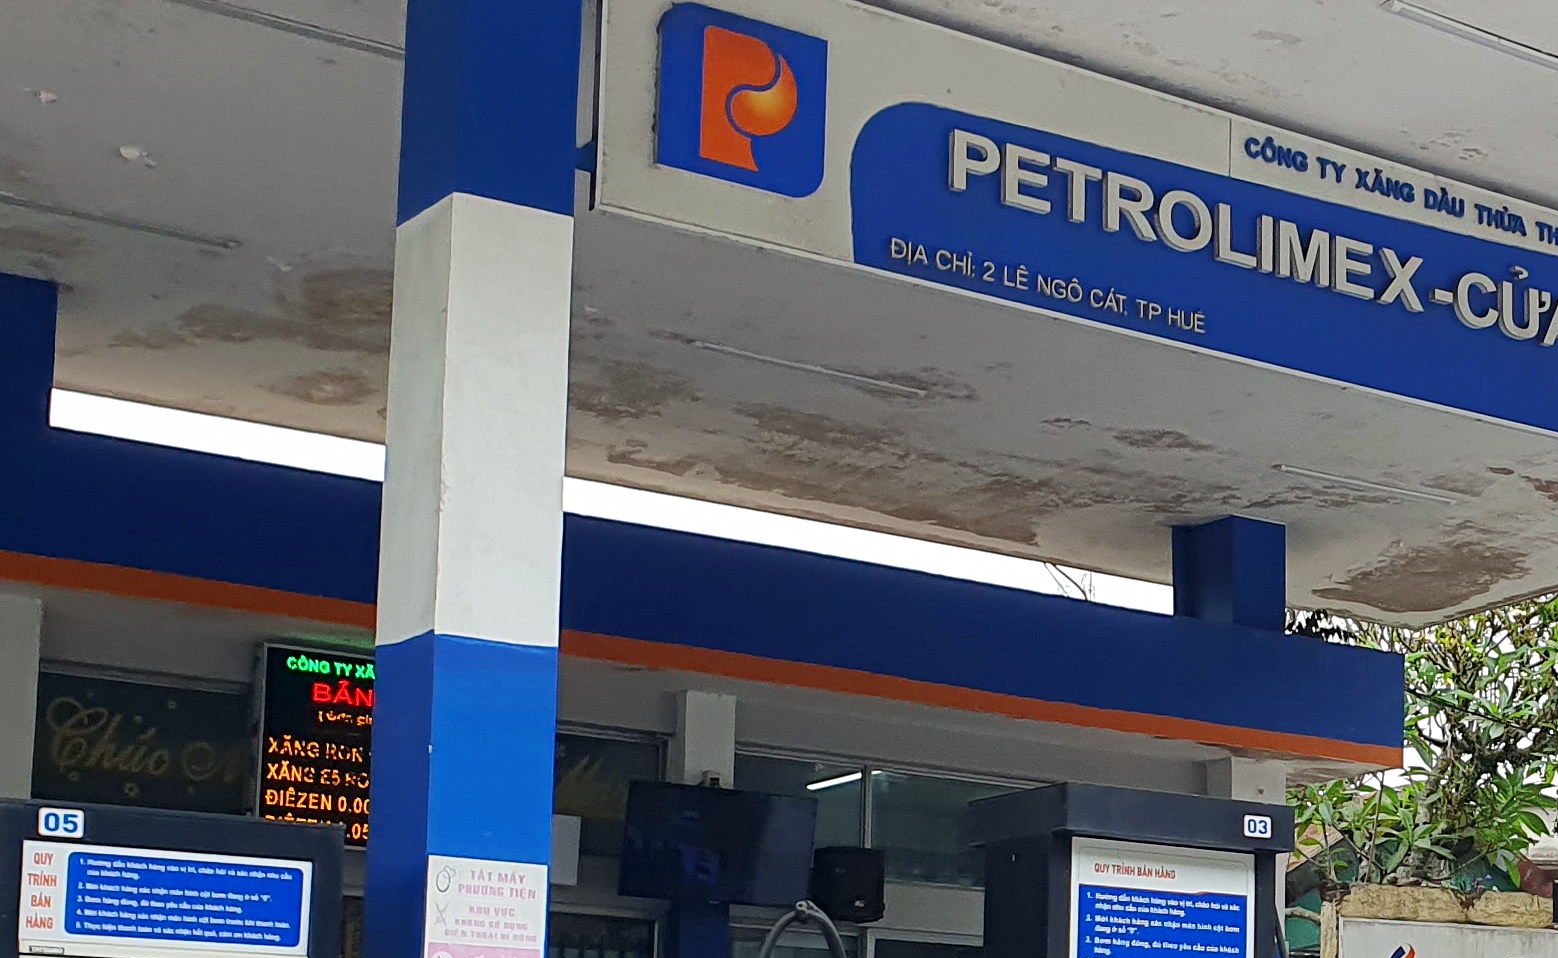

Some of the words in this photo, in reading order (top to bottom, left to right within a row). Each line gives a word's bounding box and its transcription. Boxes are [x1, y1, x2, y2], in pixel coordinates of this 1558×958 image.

[1244, 136, 1309, 173] CÔNG
[1316, 156, 1347, 183] TY
[1355, 168, 1416, 203] XĂNG
[889, 237, 928, 265] ĐỊA
[982, 261, 995, 282] 2
[1004, 264, 1029, 290] LÊ
[1037, 274, 1083, 302] NGÔ
[1135, 298, 1162, 320] TP
[287, 654, 331, 674] CÔNG
[334, 661, 353, 676] TY
[268, 734, 320, 758] XĂNG
[266, 760, 315, 783] XĂNG
[43, 812, 79, 834] 05
[1247, 818, 1268, 834] 03
[34, 852, 54, 866] QUY
[1094, 862, 1110, 874] QUY
[31, 891, 52, 908] BÁN
[25, 912, 54, 929] HÀNG
